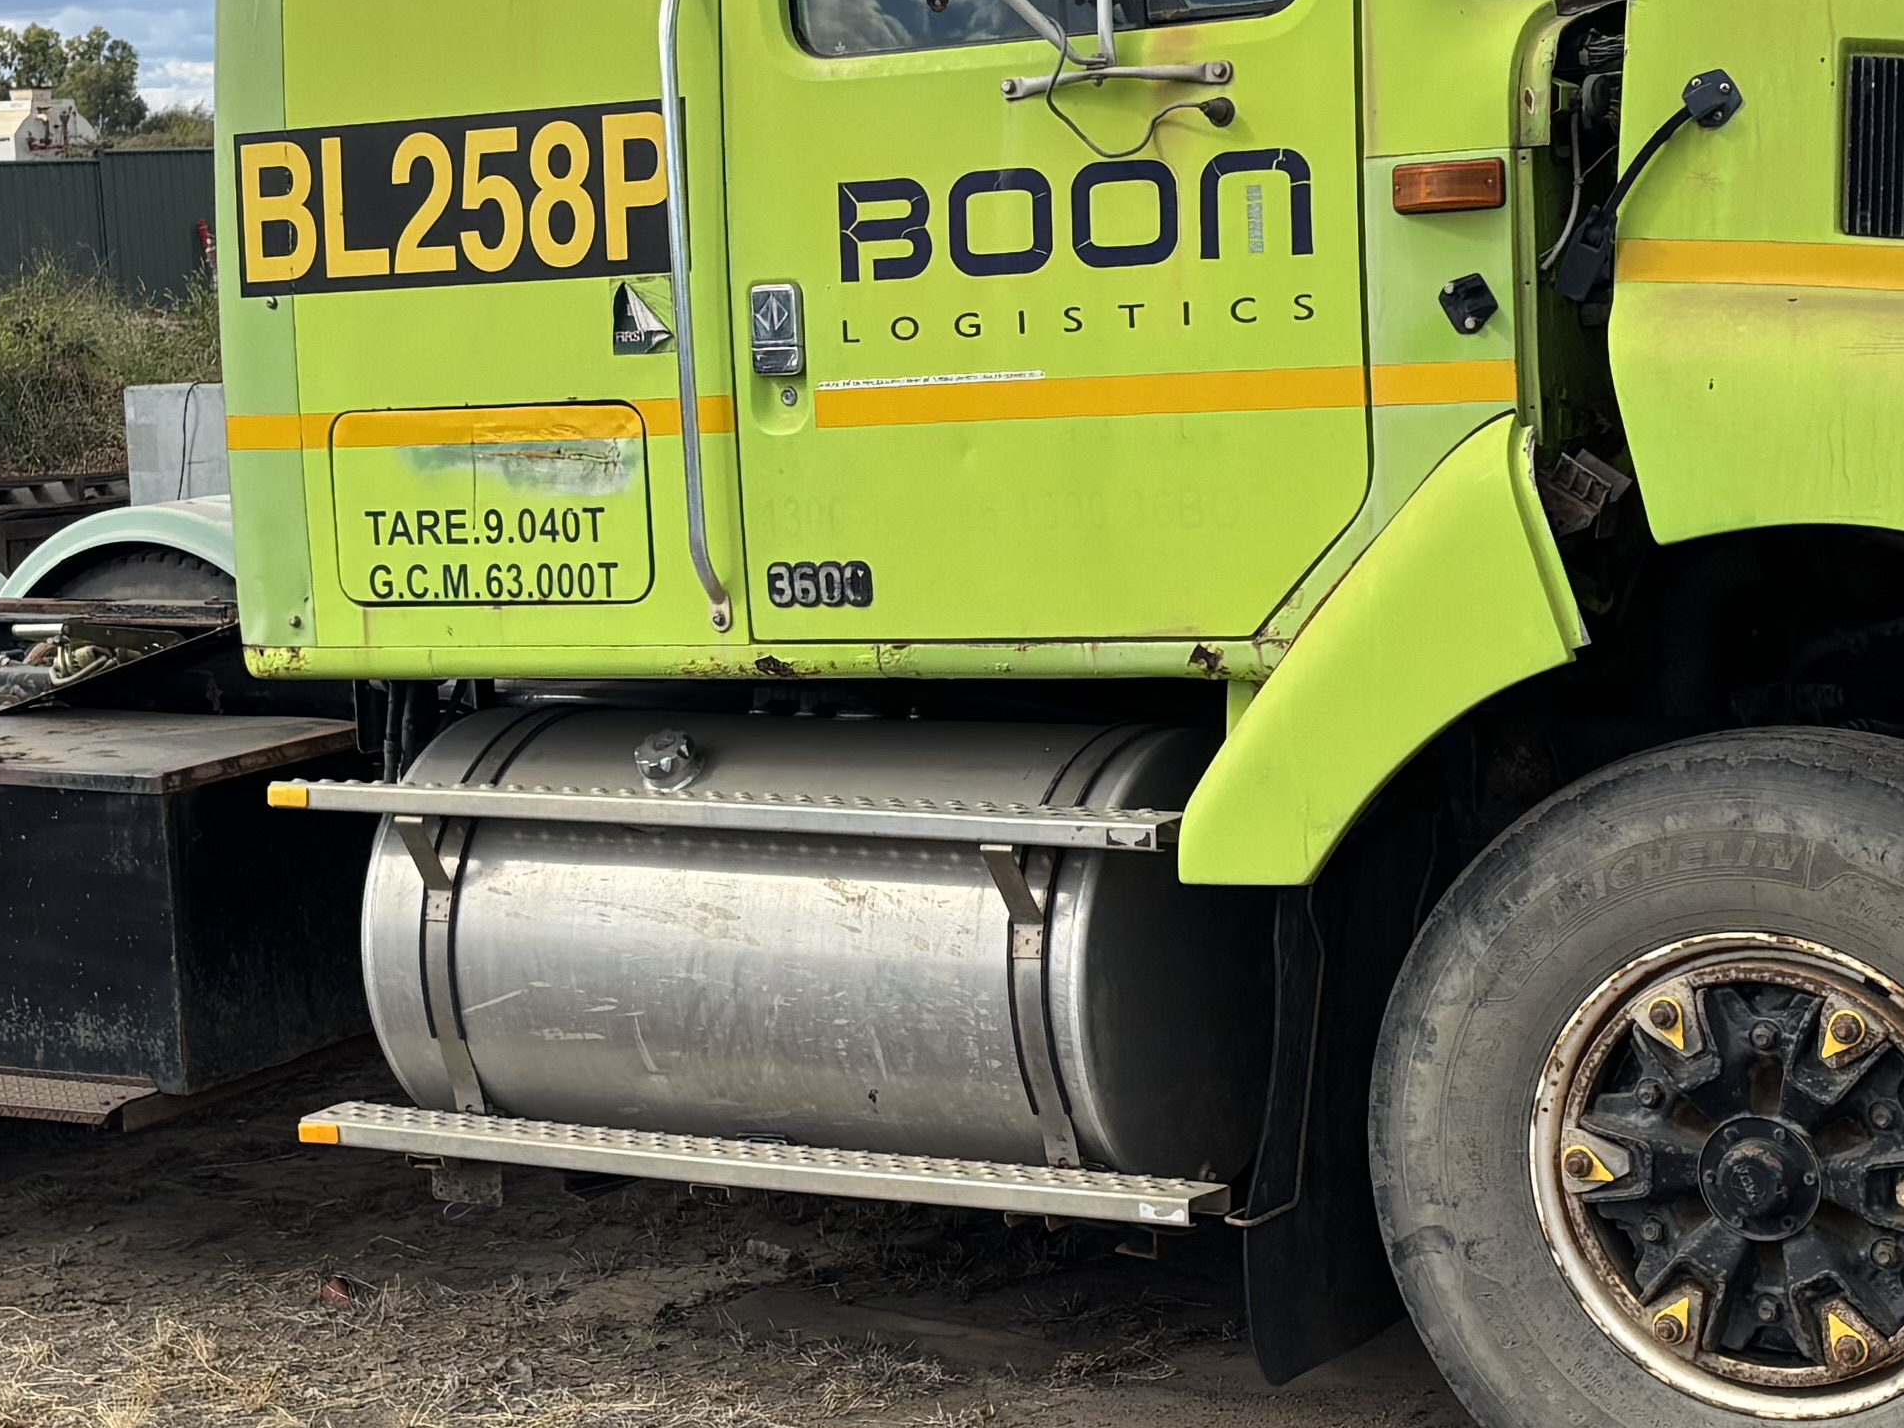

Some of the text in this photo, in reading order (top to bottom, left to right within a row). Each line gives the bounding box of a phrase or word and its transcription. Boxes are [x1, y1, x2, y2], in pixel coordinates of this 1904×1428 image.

[240, 111, 669, 284] BL258P
[838, 148, 1313, 283] BOOM
[841, 293, 1315, 345] LOGISTICS
[364, 506, 606, 547] TARE.9.040T
[369, 561, 619, 601] G.C.M.63.000T
[1547, 836, 1803, 929] MICHELIN
